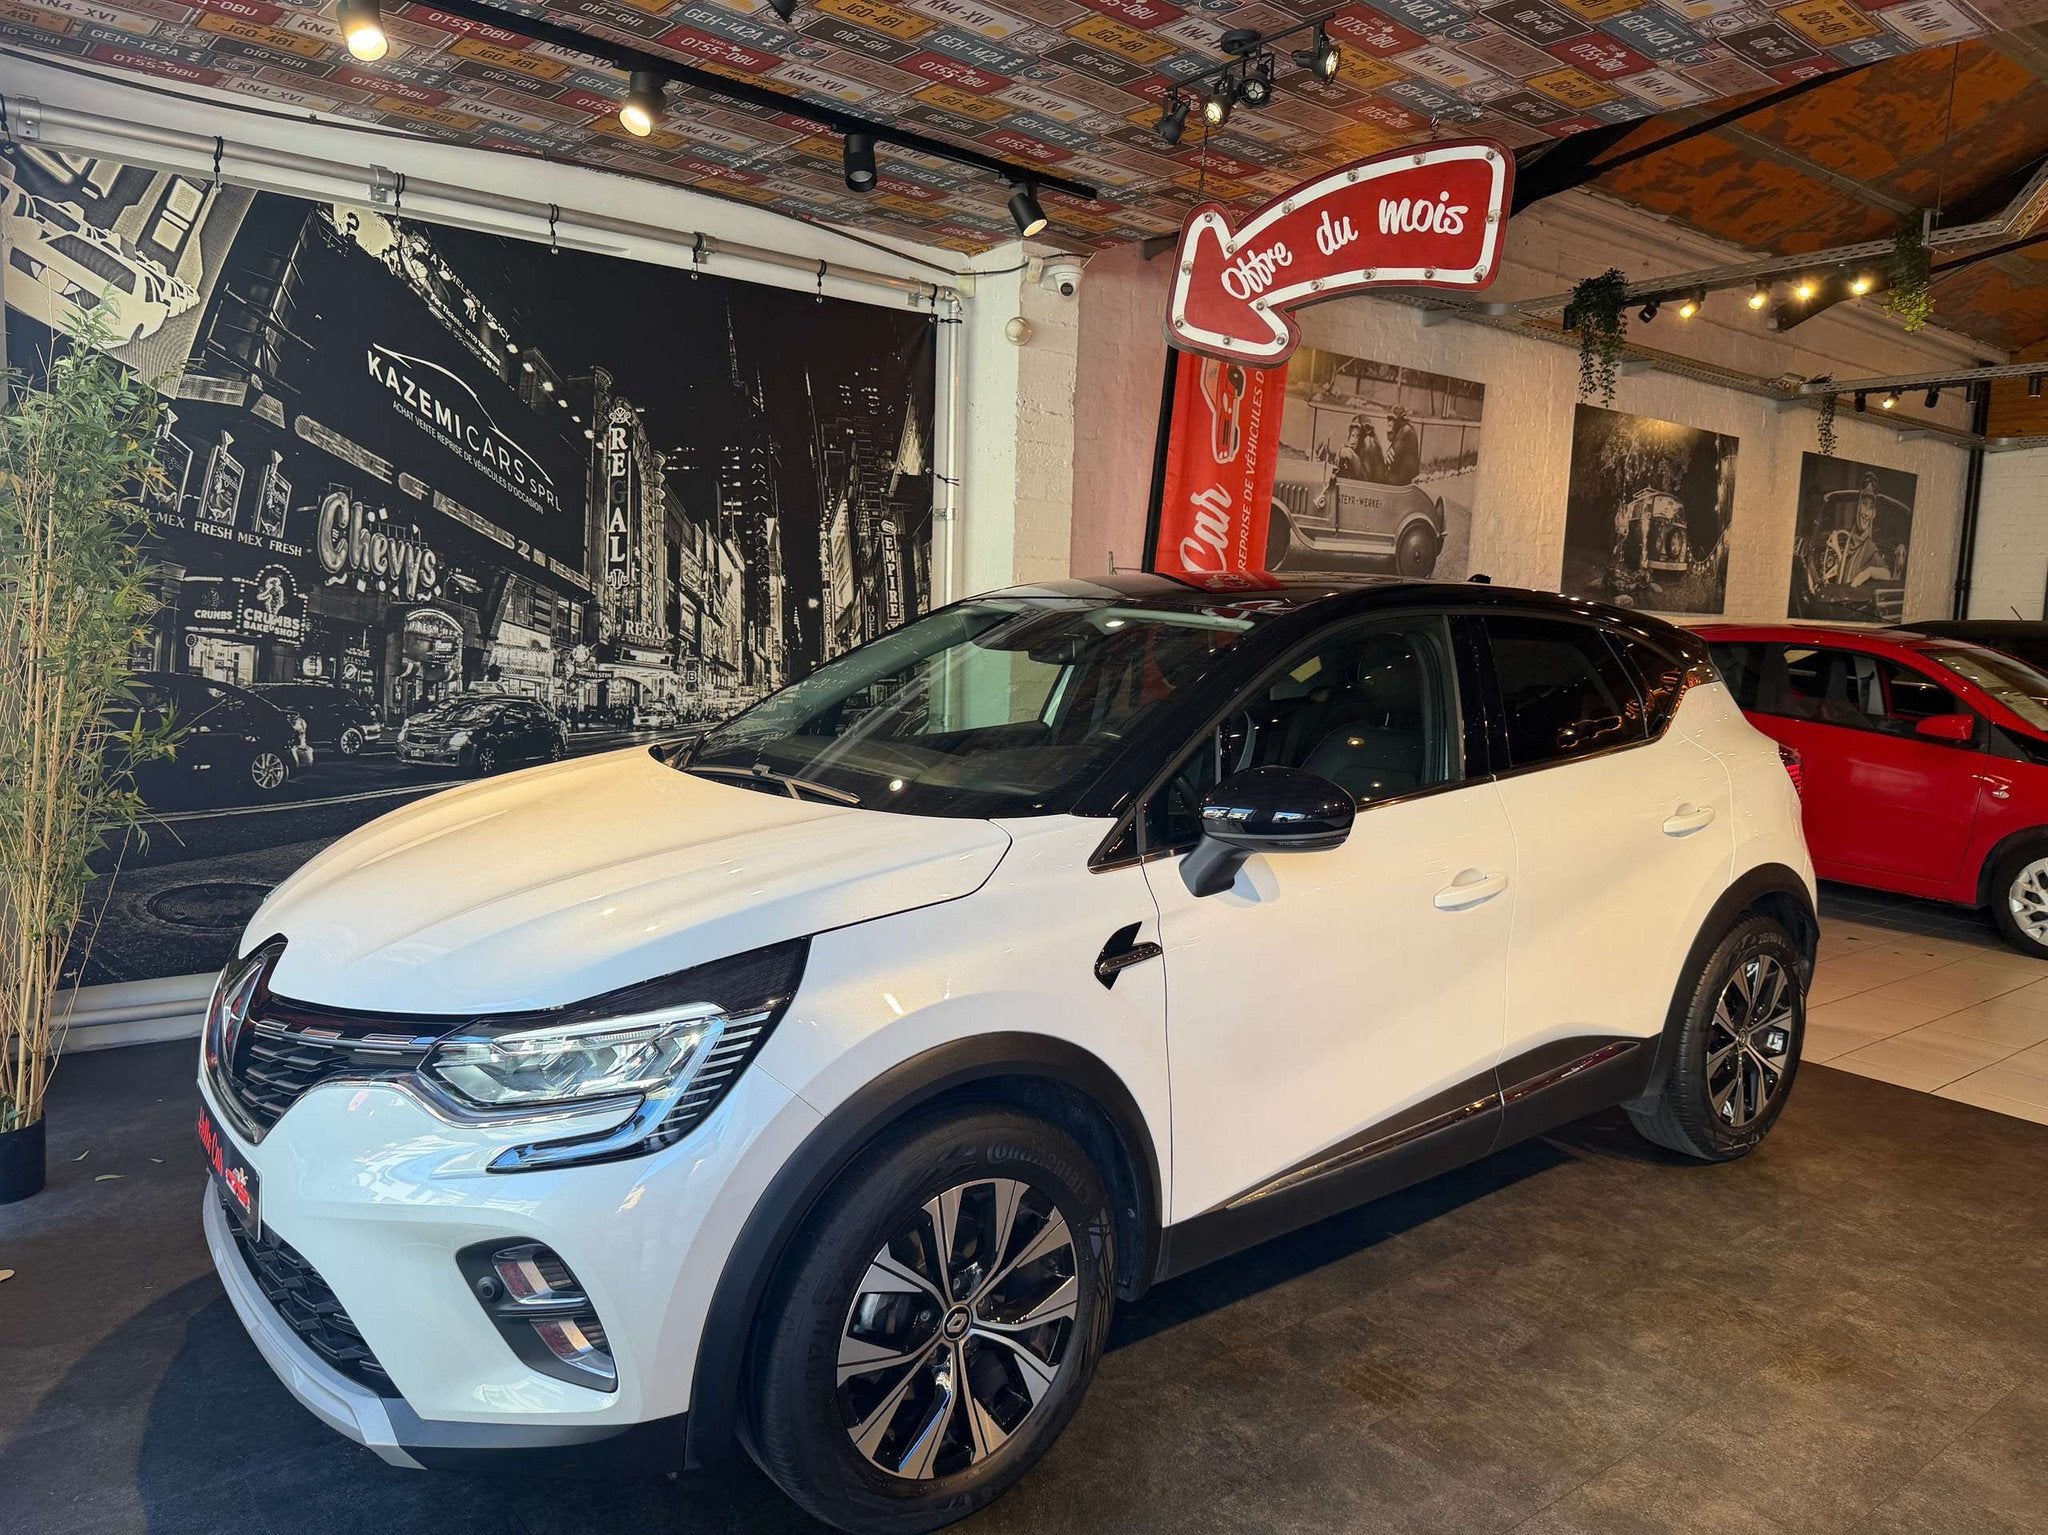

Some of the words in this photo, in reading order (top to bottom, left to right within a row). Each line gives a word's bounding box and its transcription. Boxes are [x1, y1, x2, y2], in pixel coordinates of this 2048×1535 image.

[684, 7, 765, 41] GEH-142A
[932, 33, 1005, 64] GEH-142A
[1219, 240, 1293, 300] Offre
[1316, 210, 1361, 257] du
[1378, 190, 1469, 236] mois
[367, 349, 462, 440] KAZEMI
[465, 425, 526, 485] CARS
[529, 477, 563, 513] SPRL
[393, 400, 415, 422] ACHAT
[414, 413, 437, 438] VENTE
[436, 430, 464, 458] REPRISE
[463, 453, 474, 466] DE
[472, 457, 508, 490] VÉHICULES
[507, 481, 545, 516] D'OCCASION
[1247, 386, 1265, 477] VÉHICULES
[608, 425, 630, 564] REGAL
[1179, 482, 1233, 574] Car
[1243, 480, 1255, 503] DE
[156, 511, 186, 529] MEX
[194, 521, 234, 541] FRESH
[237, 532, 263, 548] MEX
[268, 540, 303, 557] FRESH
[317, 490, 437, 600] Chevys
[1238, 502, 1252, 572] REPRISE
[193, 609, 234, 621] CRUMBS
[884, 536, 899, 619] EMPIRE
[243, 607, 302, 630] CRUMBS
[243, 619, 271, 633] BAKE
[273, 625, 301, 639] SHOP
